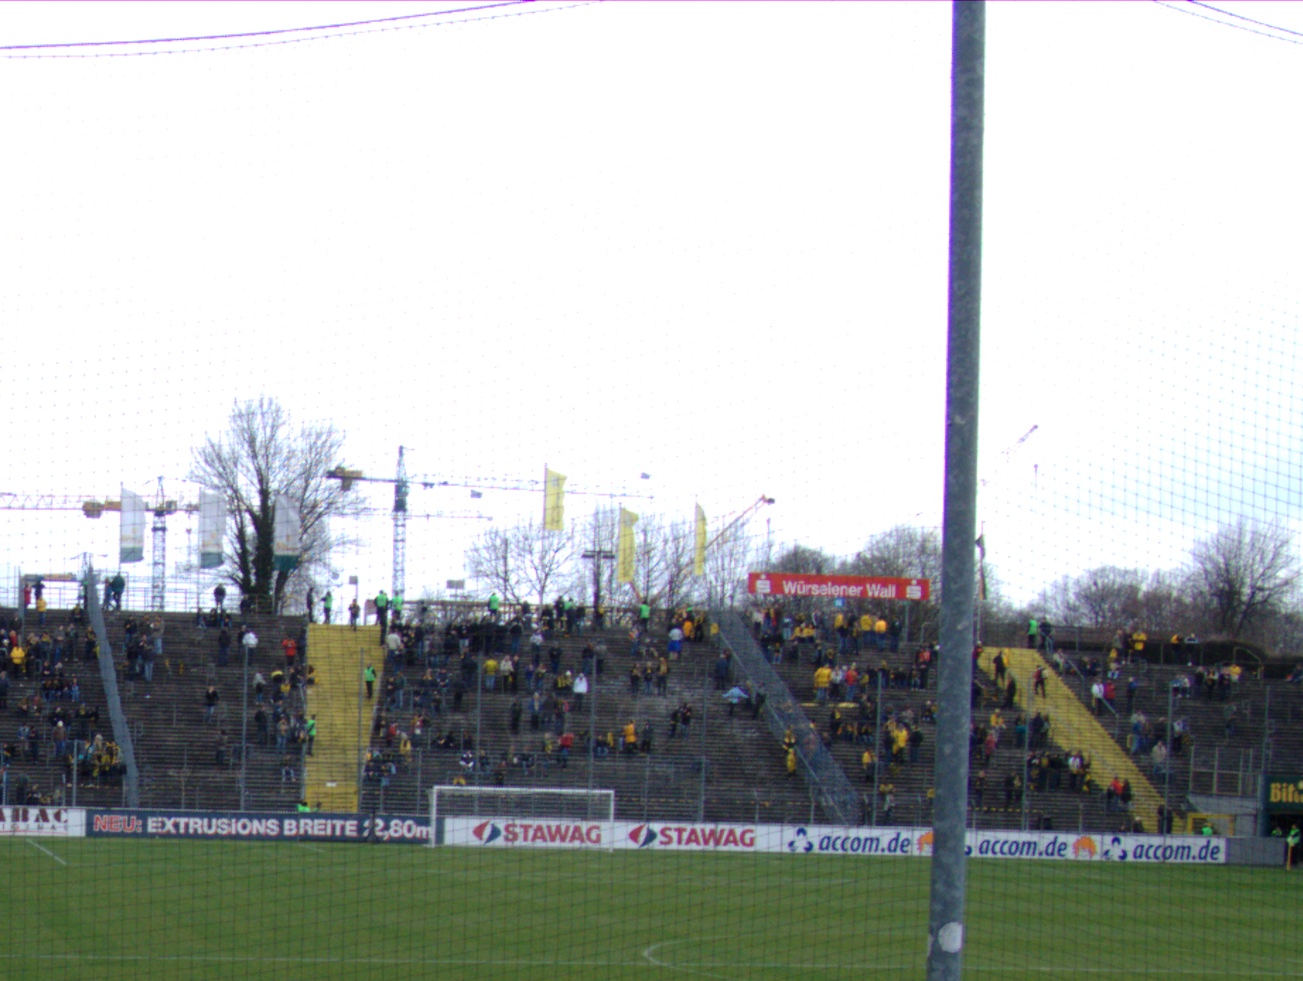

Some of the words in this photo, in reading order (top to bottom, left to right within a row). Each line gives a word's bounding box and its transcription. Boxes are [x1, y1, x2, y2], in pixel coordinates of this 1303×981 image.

[782, 580, 864, 598] Würselener
[866, 583, 896, 599] Wall
[93, 814, 143, 833] NEU:
[283, 818, 359, 837] BREITE
[503, 822, 602, 845] STAWAG
[658, 826, 756, 848] STAWAG
[818, 832, 911, 854] accom.de
[979, 836, 1067, 858] accom.de
[1133, 839, 1220, 862] accom.de
